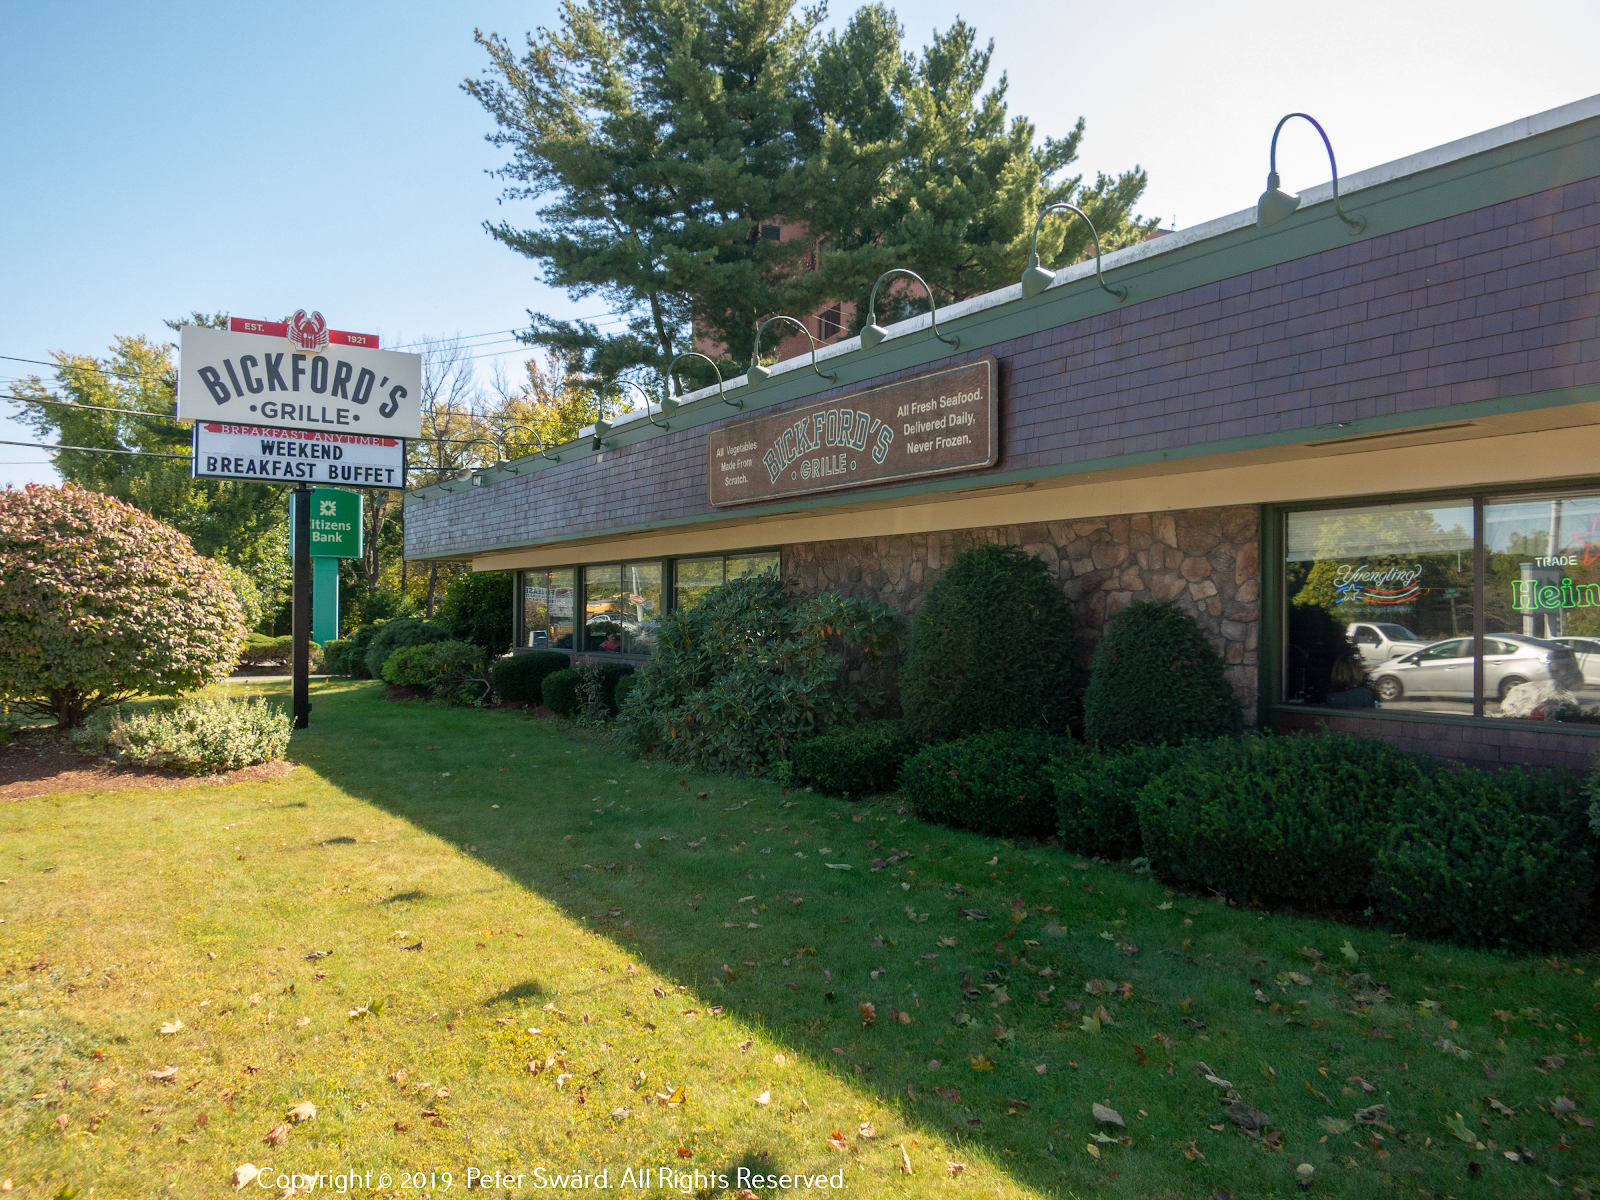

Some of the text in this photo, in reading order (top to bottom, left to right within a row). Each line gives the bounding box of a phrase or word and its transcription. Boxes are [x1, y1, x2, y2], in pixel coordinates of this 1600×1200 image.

[244, 322, 265, 332] EST.
[347, 335, 367, 345] 1921
[197, 352, 408, 419] BICKFORD'S
[897, 388, 984, 418] All Fresh Seafood.
[903, 411, 976, 436] Delivered Daily,
[220, 424, 385, 447] BREAKFAST ANYTIME!
[906, 433, 972, 454] Never Frozen.
[260, 439, 344, 461] WEEKEND
[716, 441, 758, 458] All Vegetables
[763, 408, 895, 485] BICKFORD'S
[206, 456, 395, 484] BREAKFAST BUFFET
[721, 459, 753, 472] Made From
[724, 474, 748, 487] Scratch.
[309, 519, 352, 531] itizens
[312, 531, 343, 543] Bank
[1534, 555, 1578, 567] TRADE
[1333, 564, 1423, 588] Yuengling
